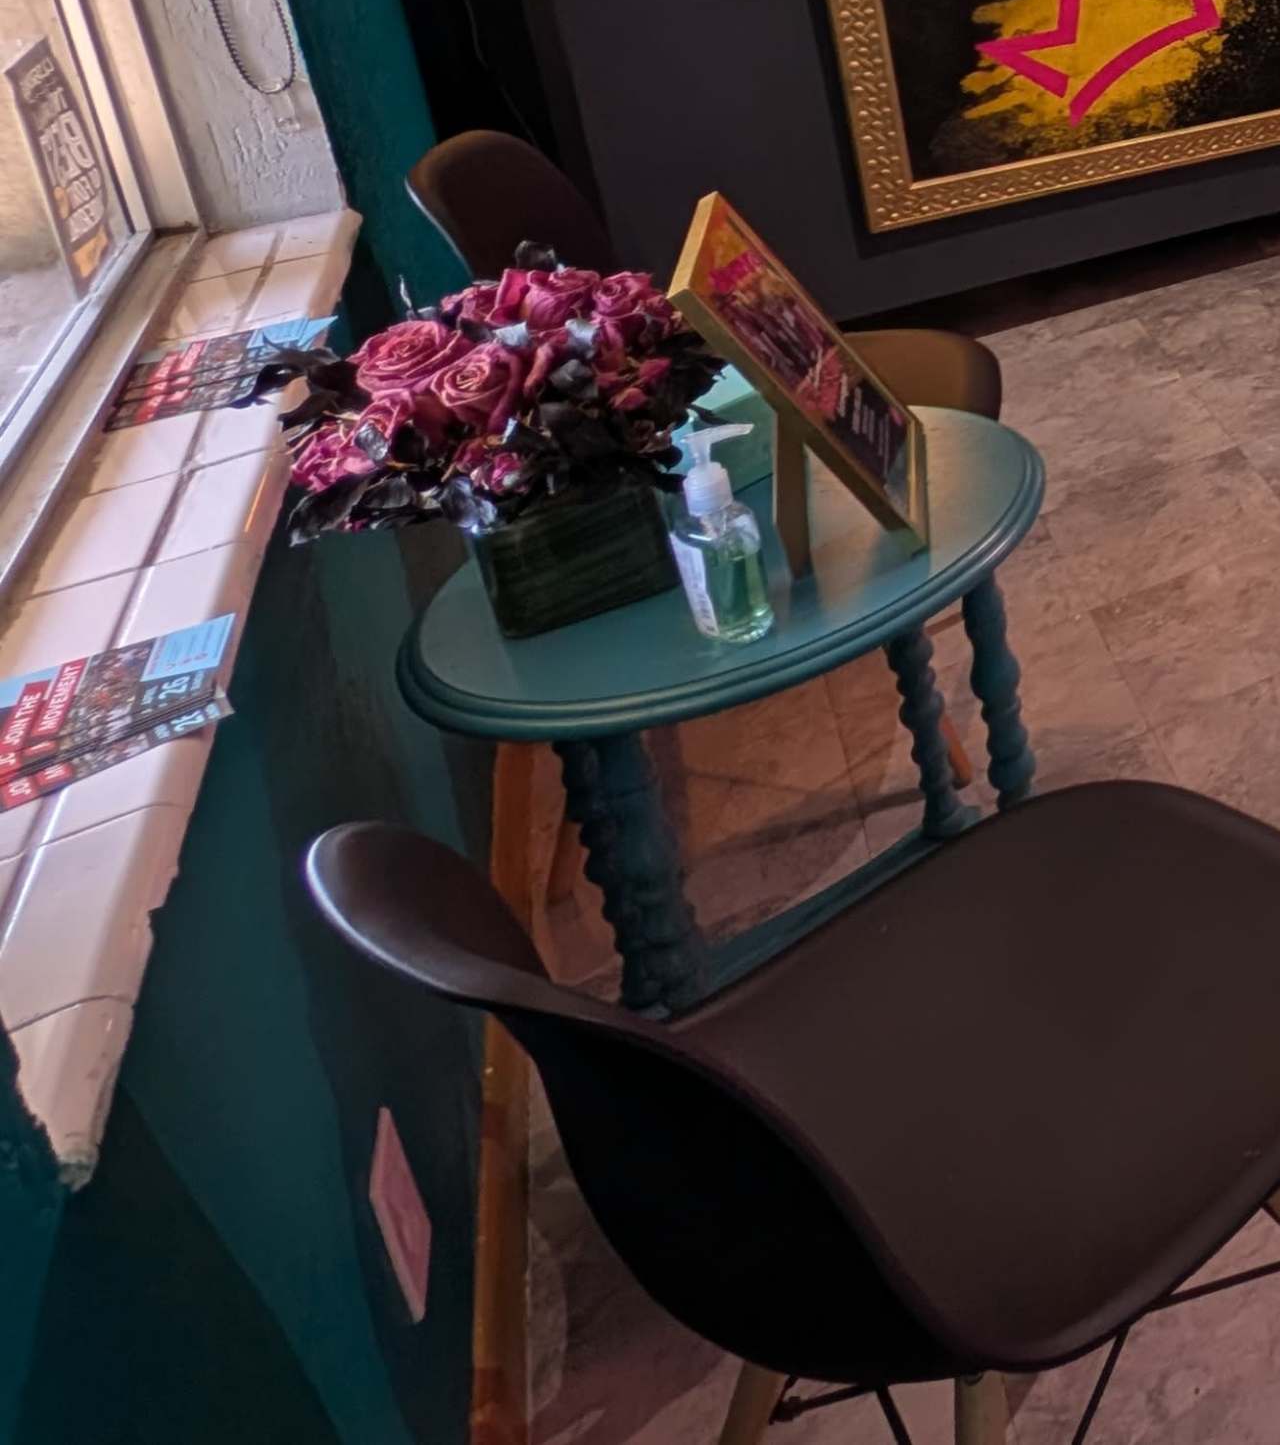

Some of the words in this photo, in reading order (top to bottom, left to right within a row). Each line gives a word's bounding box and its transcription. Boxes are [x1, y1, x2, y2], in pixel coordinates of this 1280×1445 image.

[38, 664, 82, 732] MOVEMENT
[158, 675, 190, 700] 26
[15, 692, 41, 721] THE
